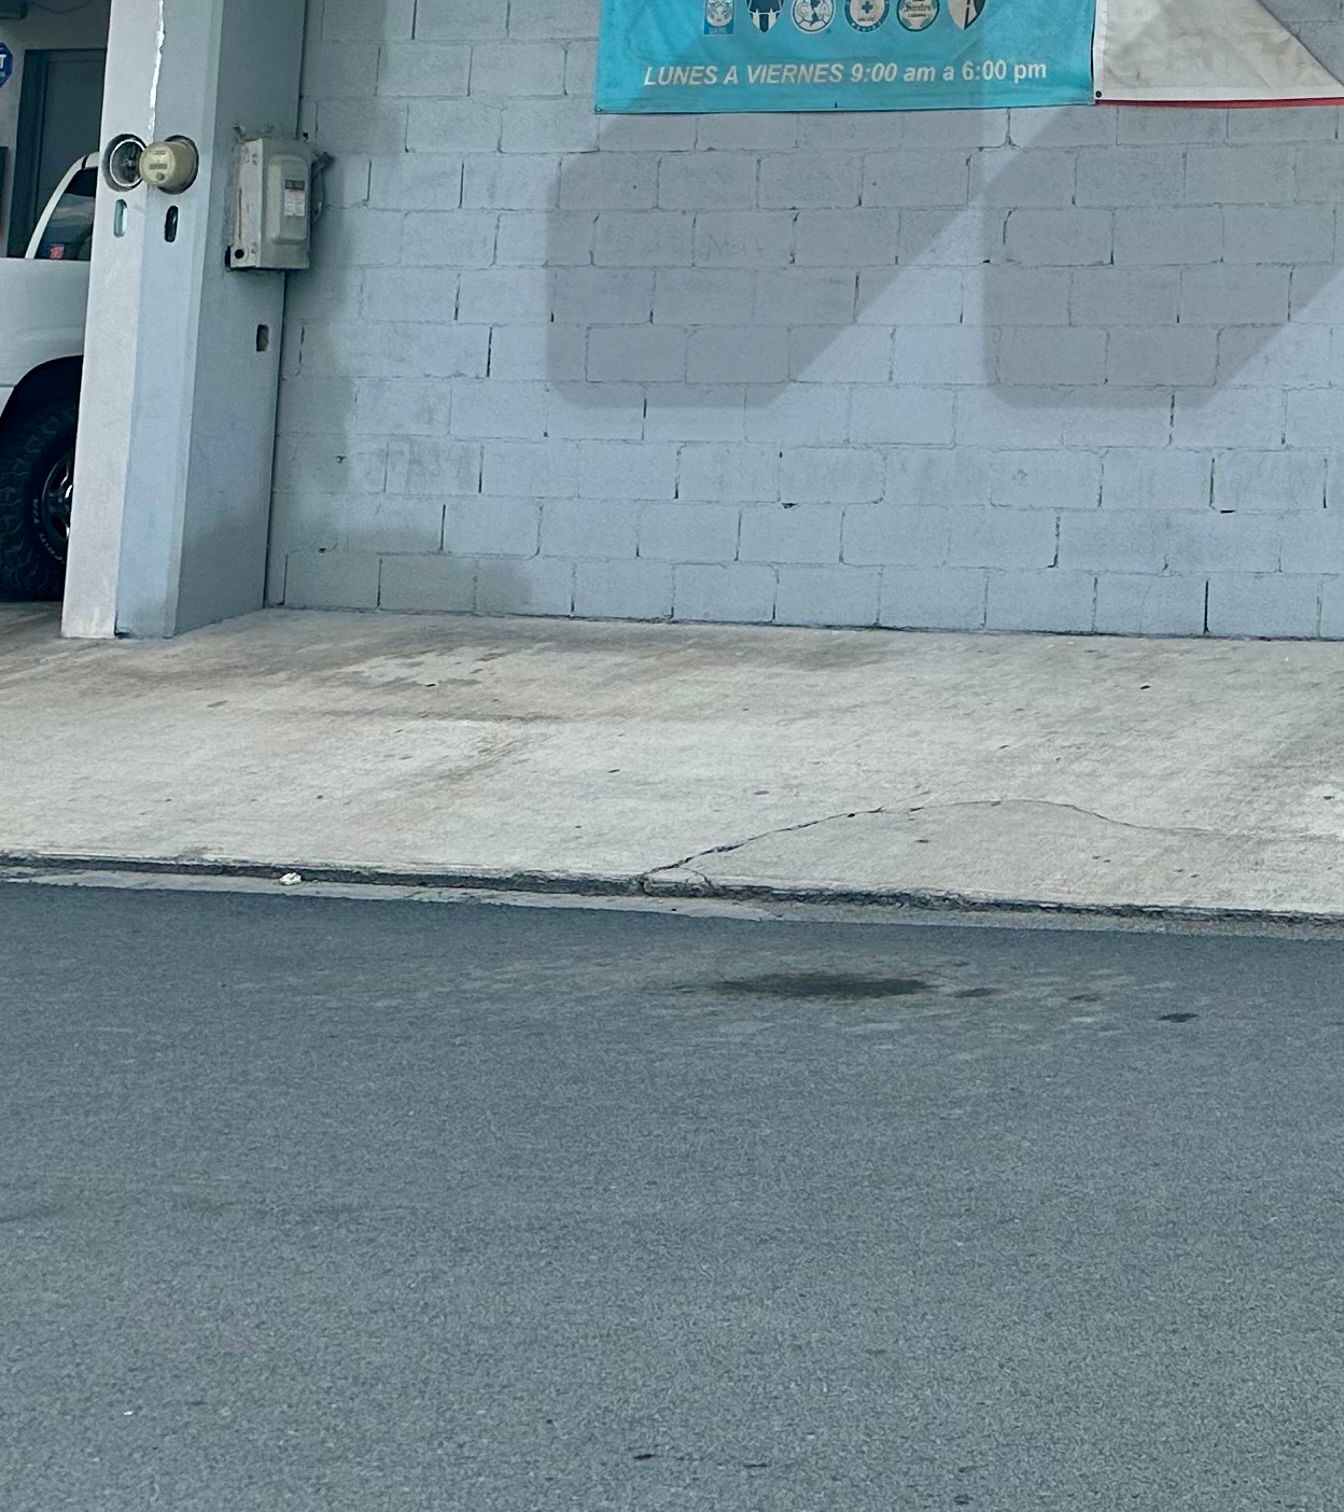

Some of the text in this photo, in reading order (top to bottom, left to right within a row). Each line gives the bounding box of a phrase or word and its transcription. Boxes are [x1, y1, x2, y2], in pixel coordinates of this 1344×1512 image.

[643, 59, 1047, 86] LUNES A VIERNES 9:00 am a 6:00 pm
